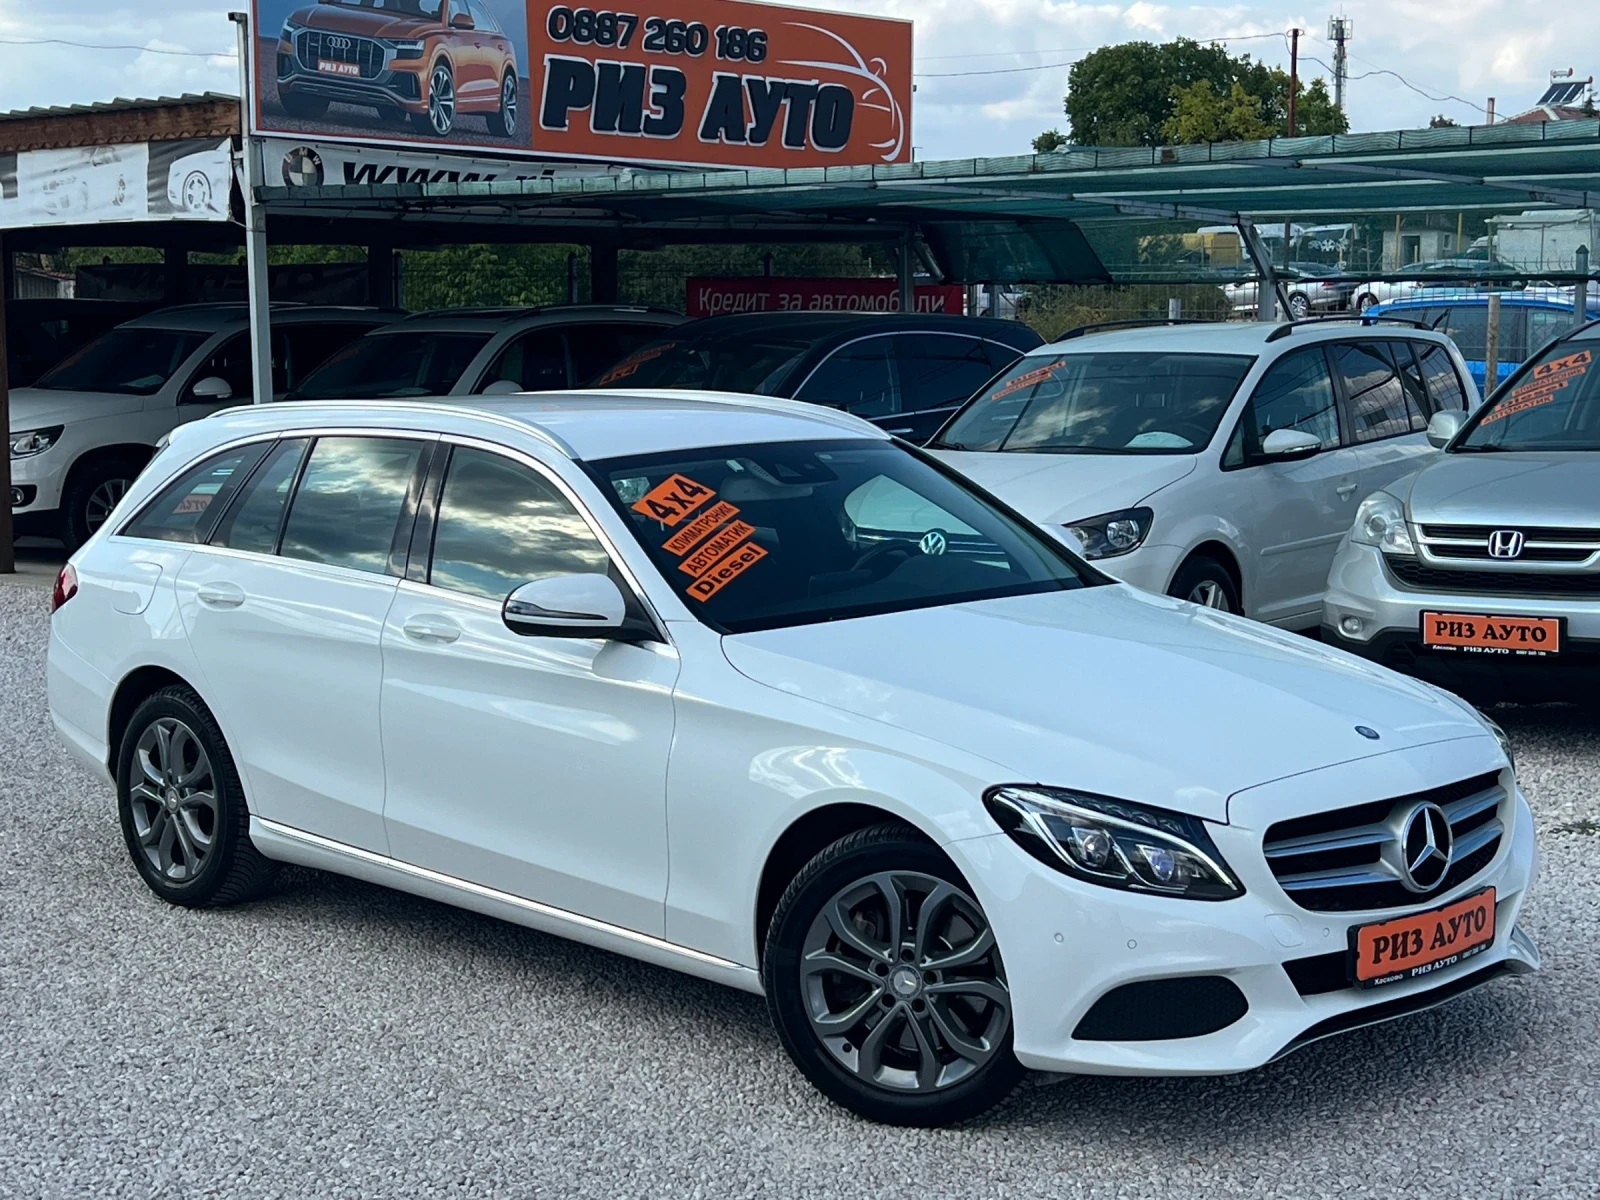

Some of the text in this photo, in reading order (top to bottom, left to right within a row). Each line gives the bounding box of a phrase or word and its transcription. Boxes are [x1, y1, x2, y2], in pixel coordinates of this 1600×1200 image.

[546, 5, 768, 63] 0887 260 186
[539, 54, 854, 152] РИЗ АУТО
[699, 288, 945, 315] Кредит за автомобли
[1537, 353, 1589, 376] 4x4
[645, 478, 709, 520] 4x4
[668, 503, 731, 553] КЛИМАТРОНИК
[686, 522, 751, 574] АВТОМАТИК
[693, 546, 762, 596] Diesel
[1435, 620, 1547, 643] РИЗ АУТО
[1483, 647, 1510, 655] АУТО
[1372, 906, 1487, 965] РИЗ АУТО
[1411, 963, 1432, 977] РИЗ
[1433, 955, 1458, 970] АУТО
